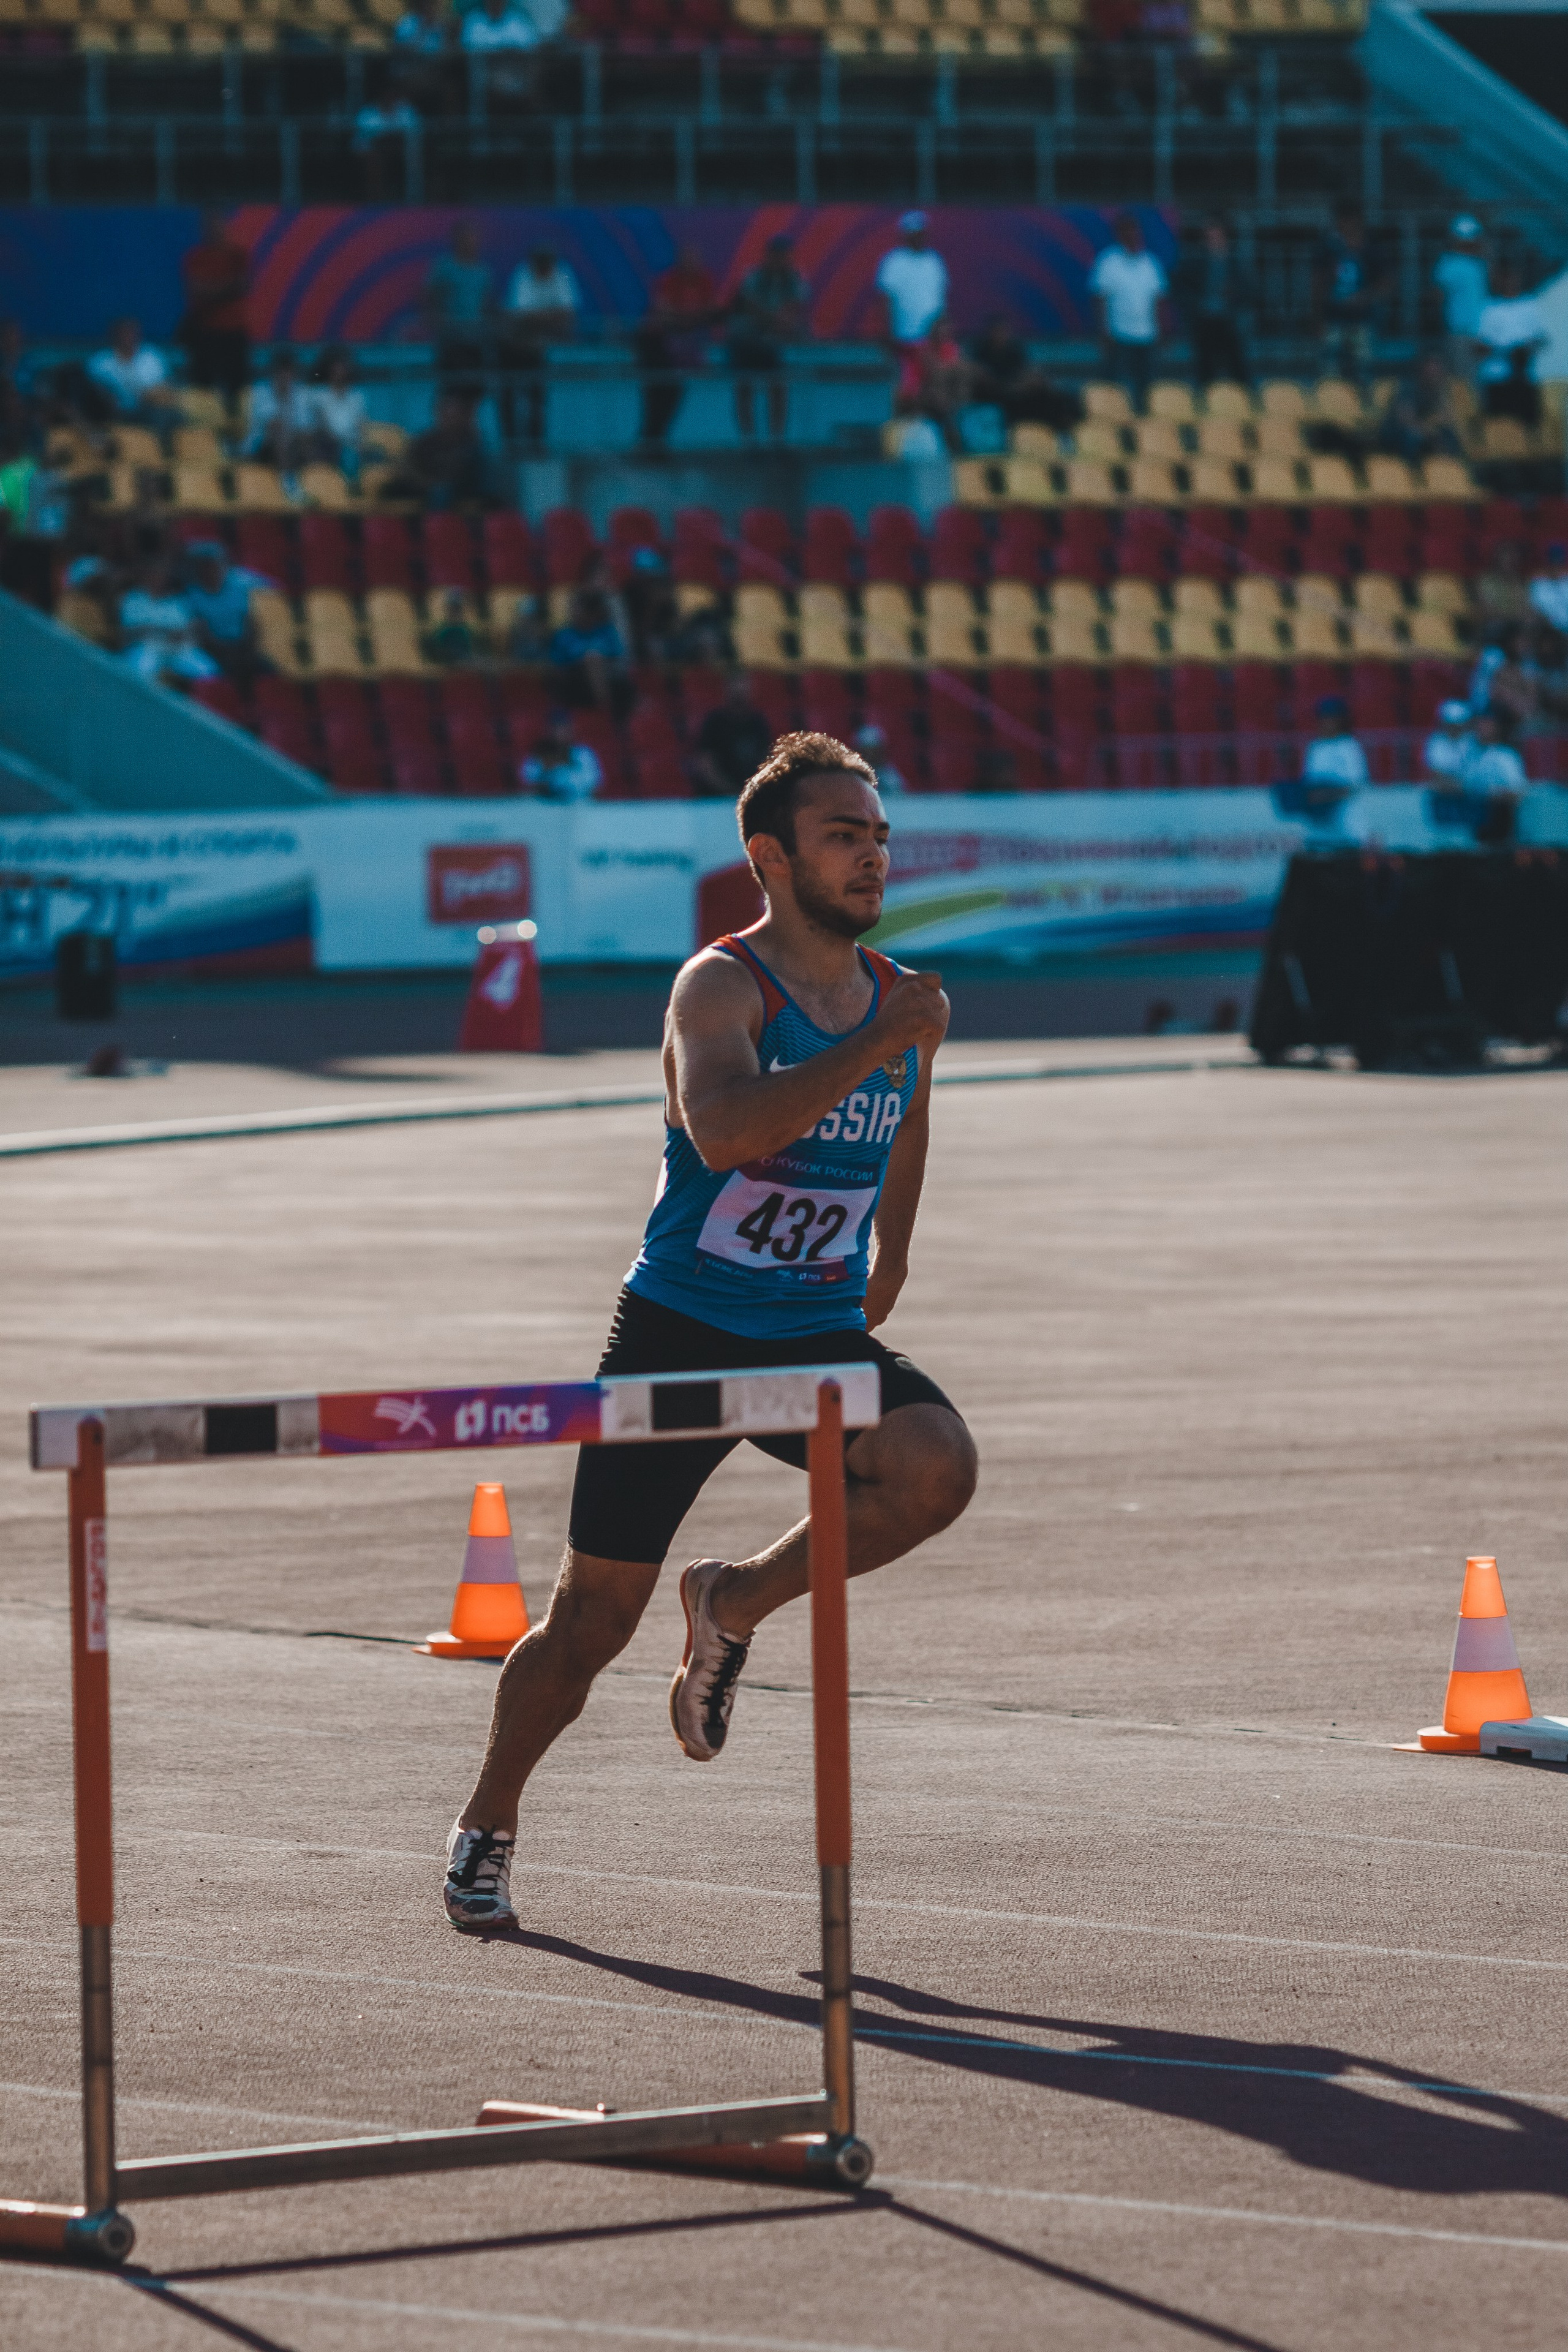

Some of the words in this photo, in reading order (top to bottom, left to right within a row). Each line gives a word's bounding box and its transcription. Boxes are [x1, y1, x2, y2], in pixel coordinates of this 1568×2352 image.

[801, 1092, 902, 1144] SSIA
[777, 1156, 821, 1175] КУБОК
[824, 1166, 873, 1182] РОССИИ
[736, 1192, 848, 1262] 432
